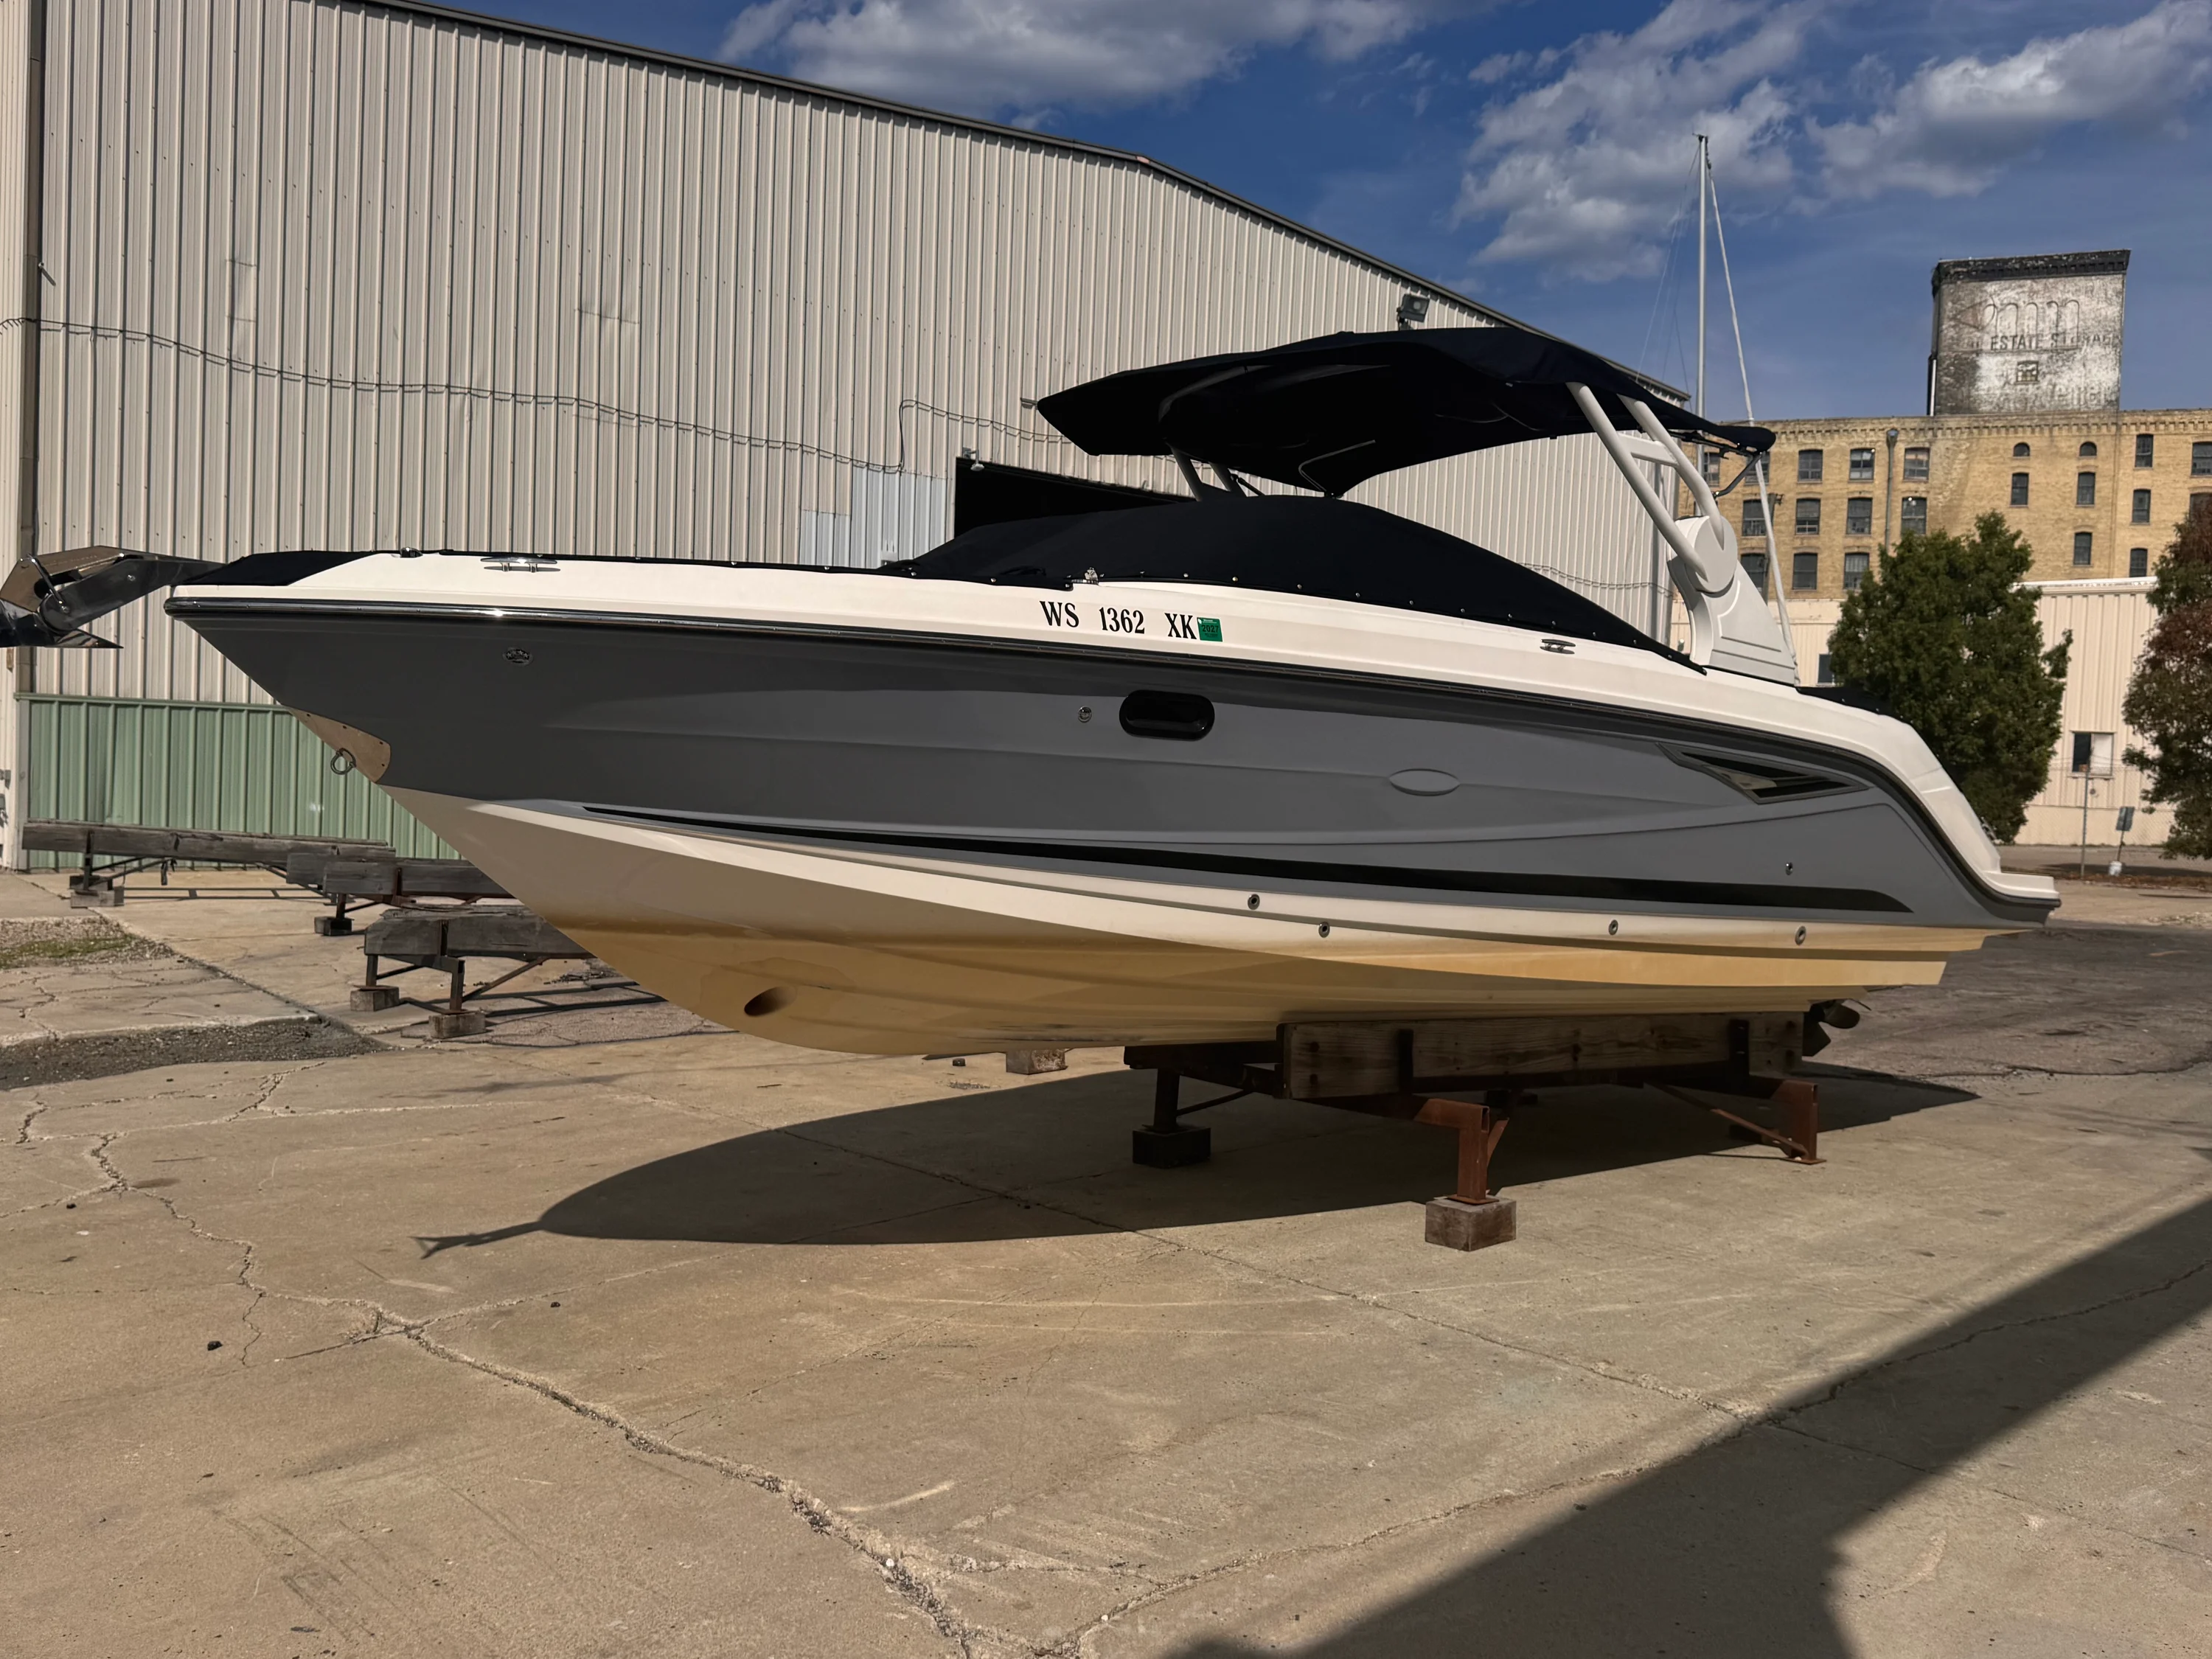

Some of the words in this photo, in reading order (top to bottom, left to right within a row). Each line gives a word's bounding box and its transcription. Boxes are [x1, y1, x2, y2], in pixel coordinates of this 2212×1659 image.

[1991, 334, 2043, 350] ESTATE
[1040, 601, 1079, 627] WS
[1099, 607, 1145, 634] 1362
[1164, 613, 1197, 639] XK
[1201, 624, 1219, 633] 2027
